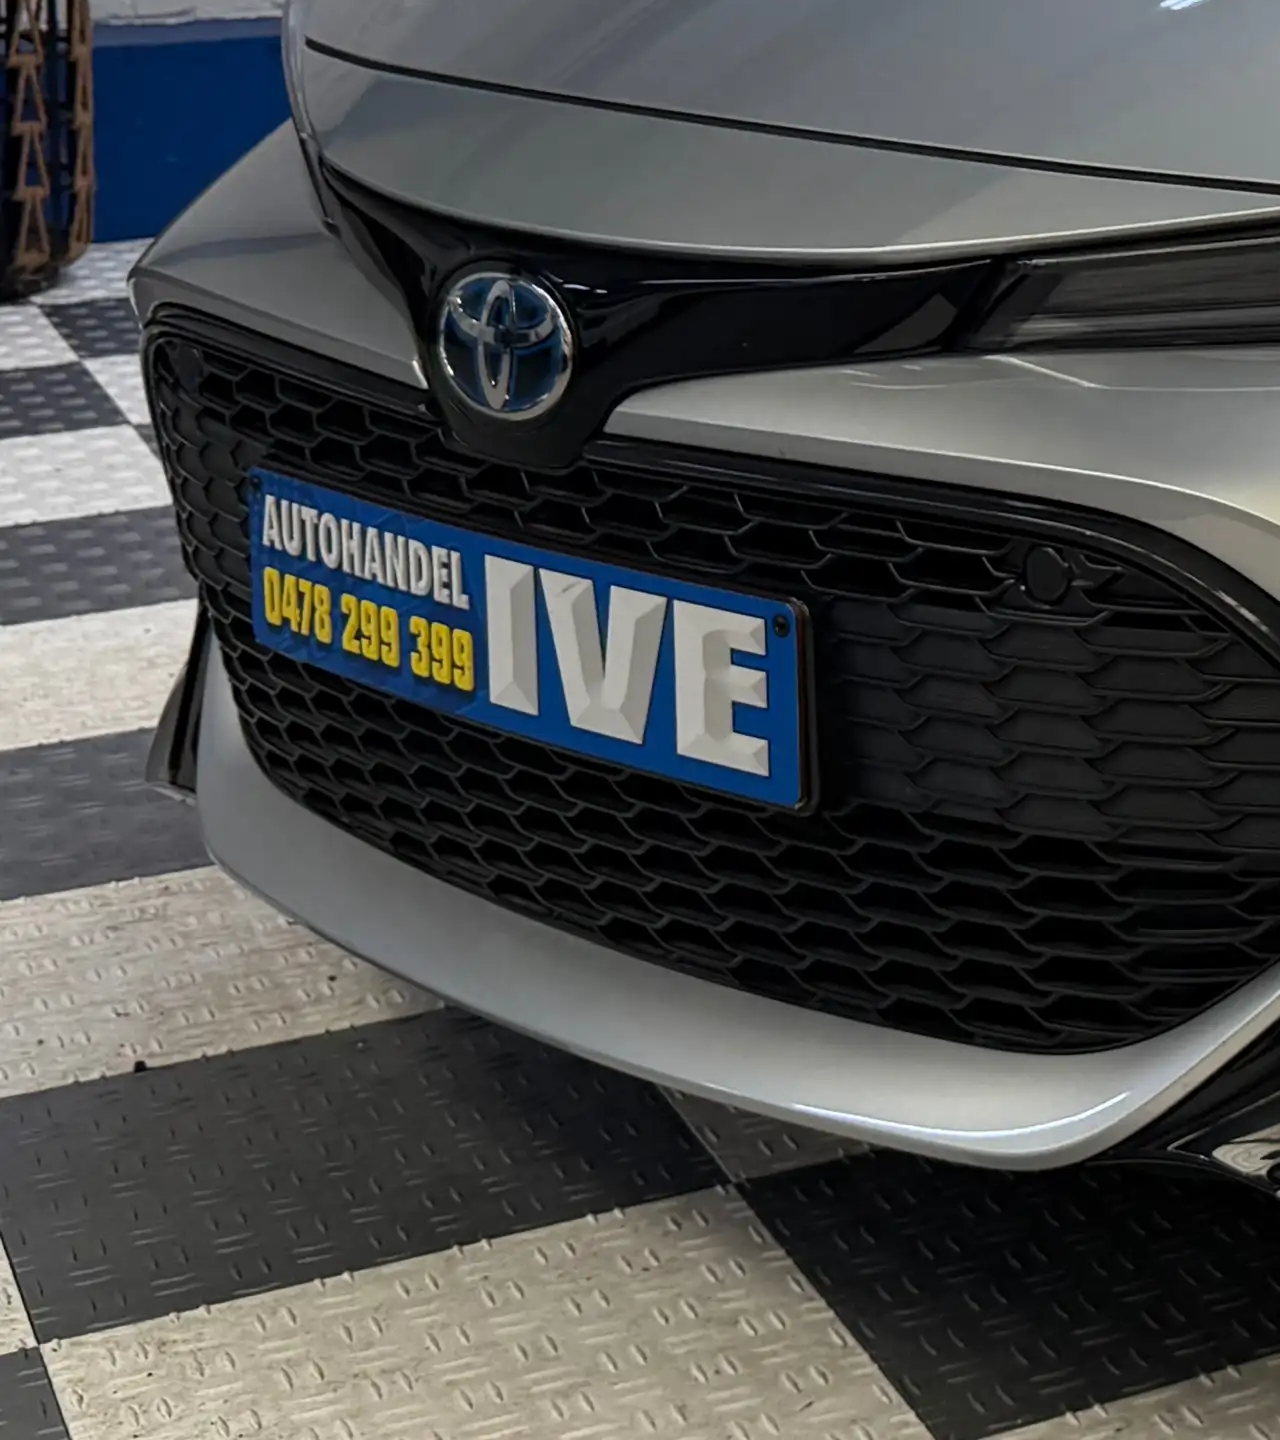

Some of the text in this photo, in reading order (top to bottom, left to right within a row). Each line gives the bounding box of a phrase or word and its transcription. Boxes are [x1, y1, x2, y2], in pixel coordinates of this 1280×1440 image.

[262, 493, 470, 610] AUTOHANDEL
[263, 567, 475, 692] 0478 299 399
[484, 554, 770, 777] IVE
